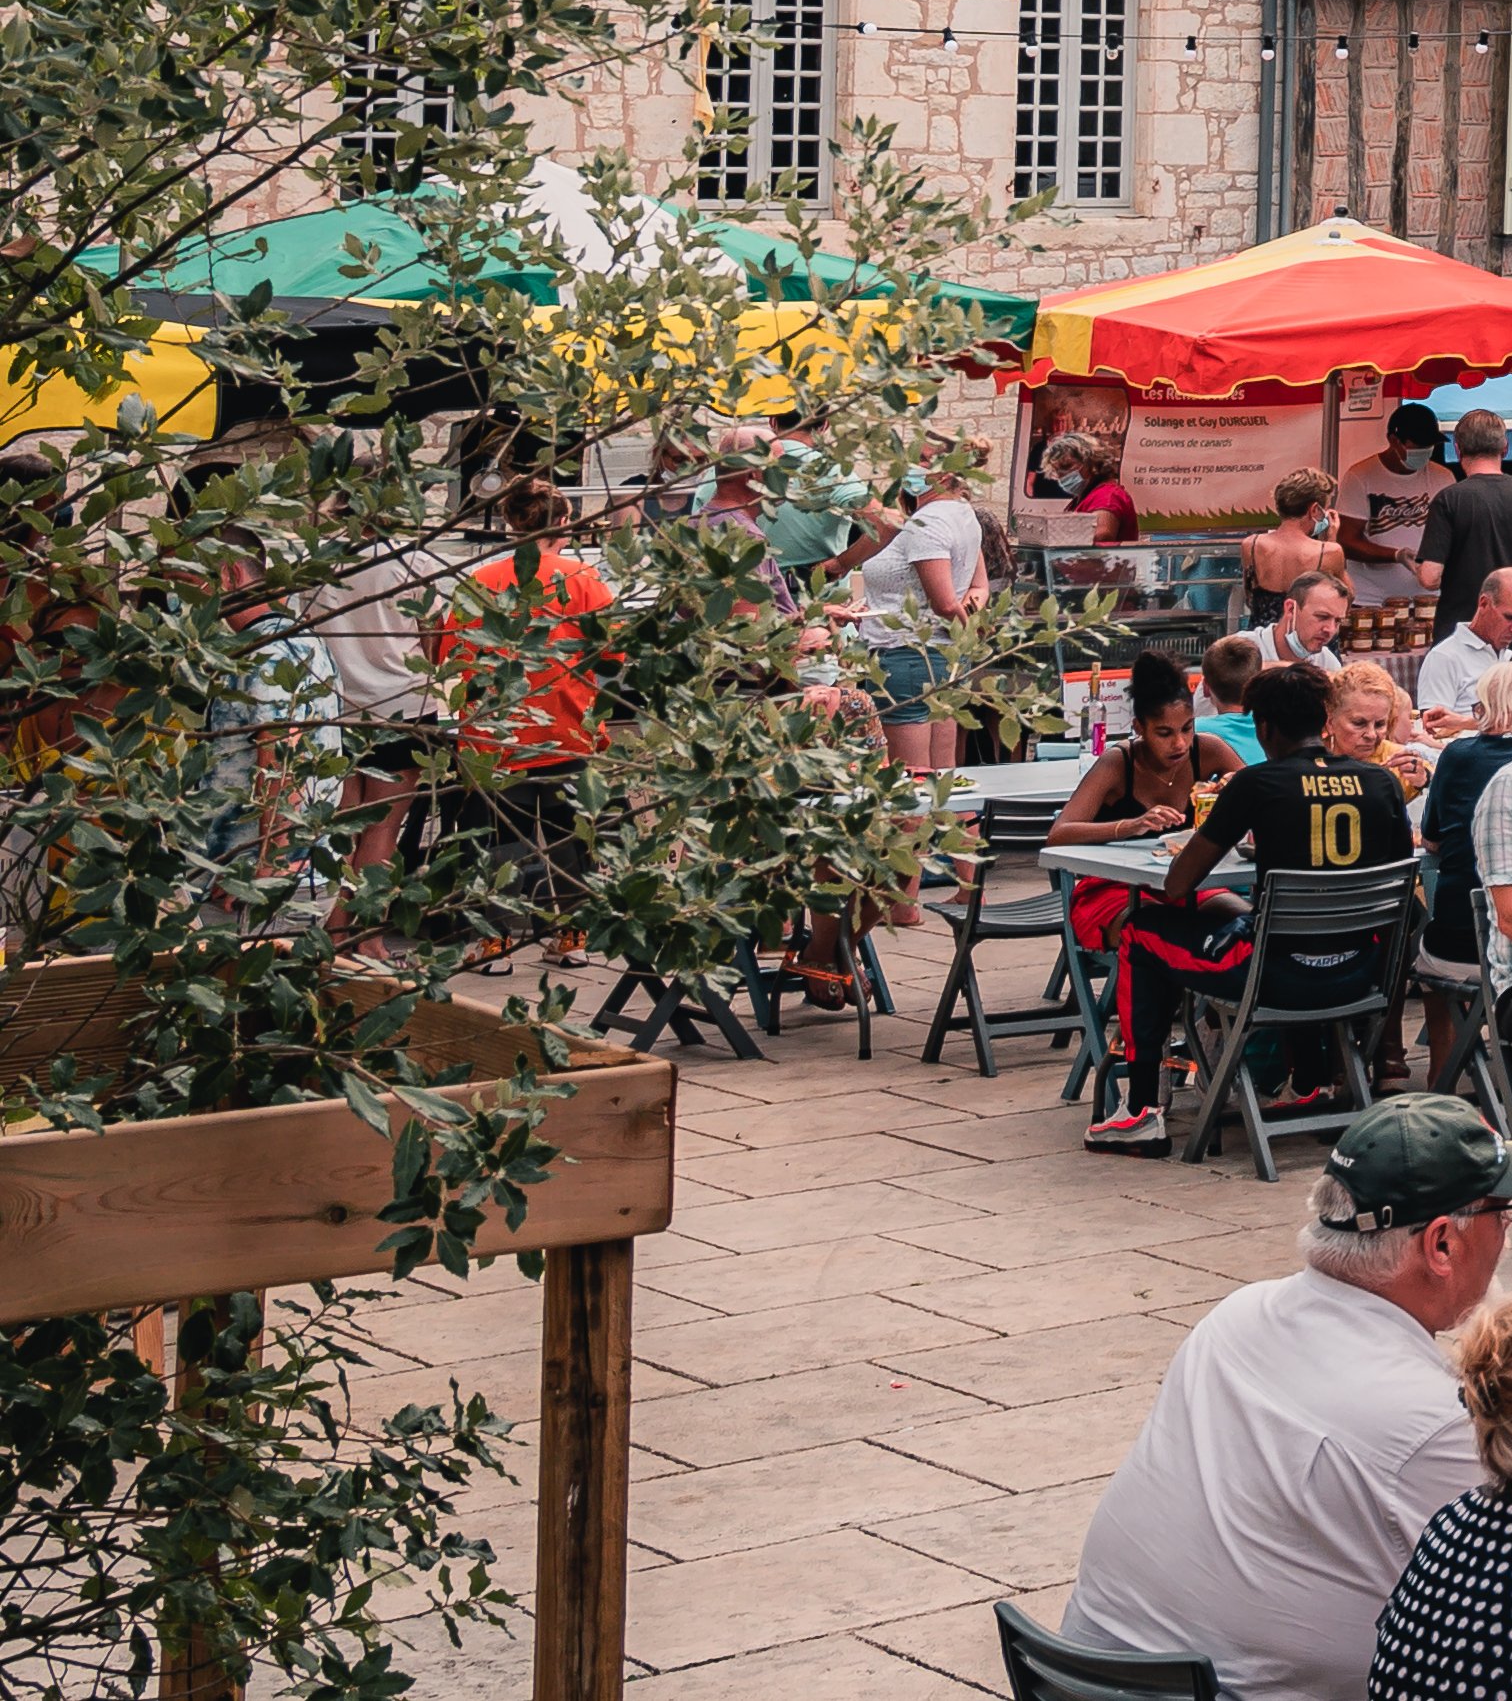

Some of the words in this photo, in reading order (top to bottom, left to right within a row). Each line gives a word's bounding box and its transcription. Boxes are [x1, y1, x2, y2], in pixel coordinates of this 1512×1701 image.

[1144, 416, 1185, 430] Solange
[1187, 417, 1198, 428] et
[1140, 438, 1185, 449] Conserves
[1187, 438, 1199, 448] de
[1302, 775, 1363, 797] MESSI
[1310, 803, 1362, 867] 10
